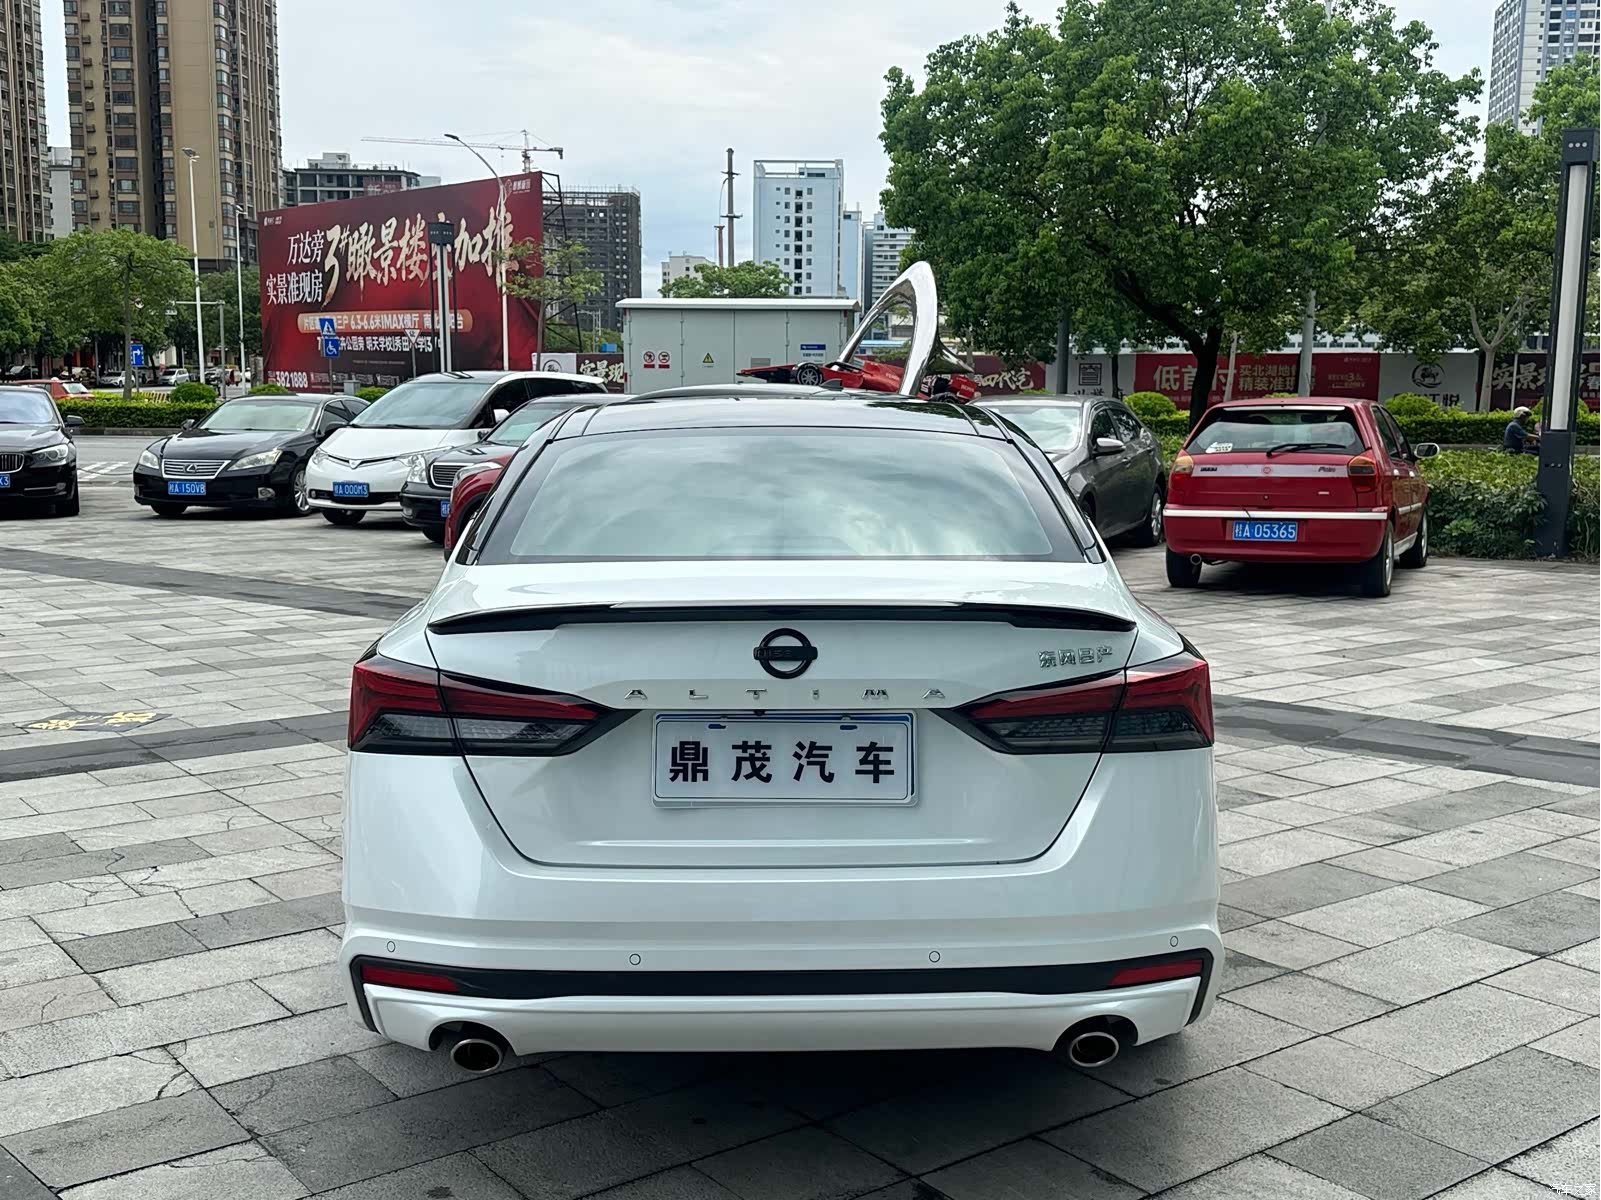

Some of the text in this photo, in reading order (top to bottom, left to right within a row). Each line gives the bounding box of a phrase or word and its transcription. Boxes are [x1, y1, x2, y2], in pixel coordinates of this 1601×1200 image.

[287, 229, 325, 266] 万达旁
[266, 268, 323, 305] 实景准现房
[275, 371, 309, 389] 3821888
[1239, 377, 1316, 391] 精装准现
[1039, 645, 1113, 668] 东风日产
[624, 688, 946, 700] ALTIMA
[669, 740, 895, 784] 鼎茂汽车
